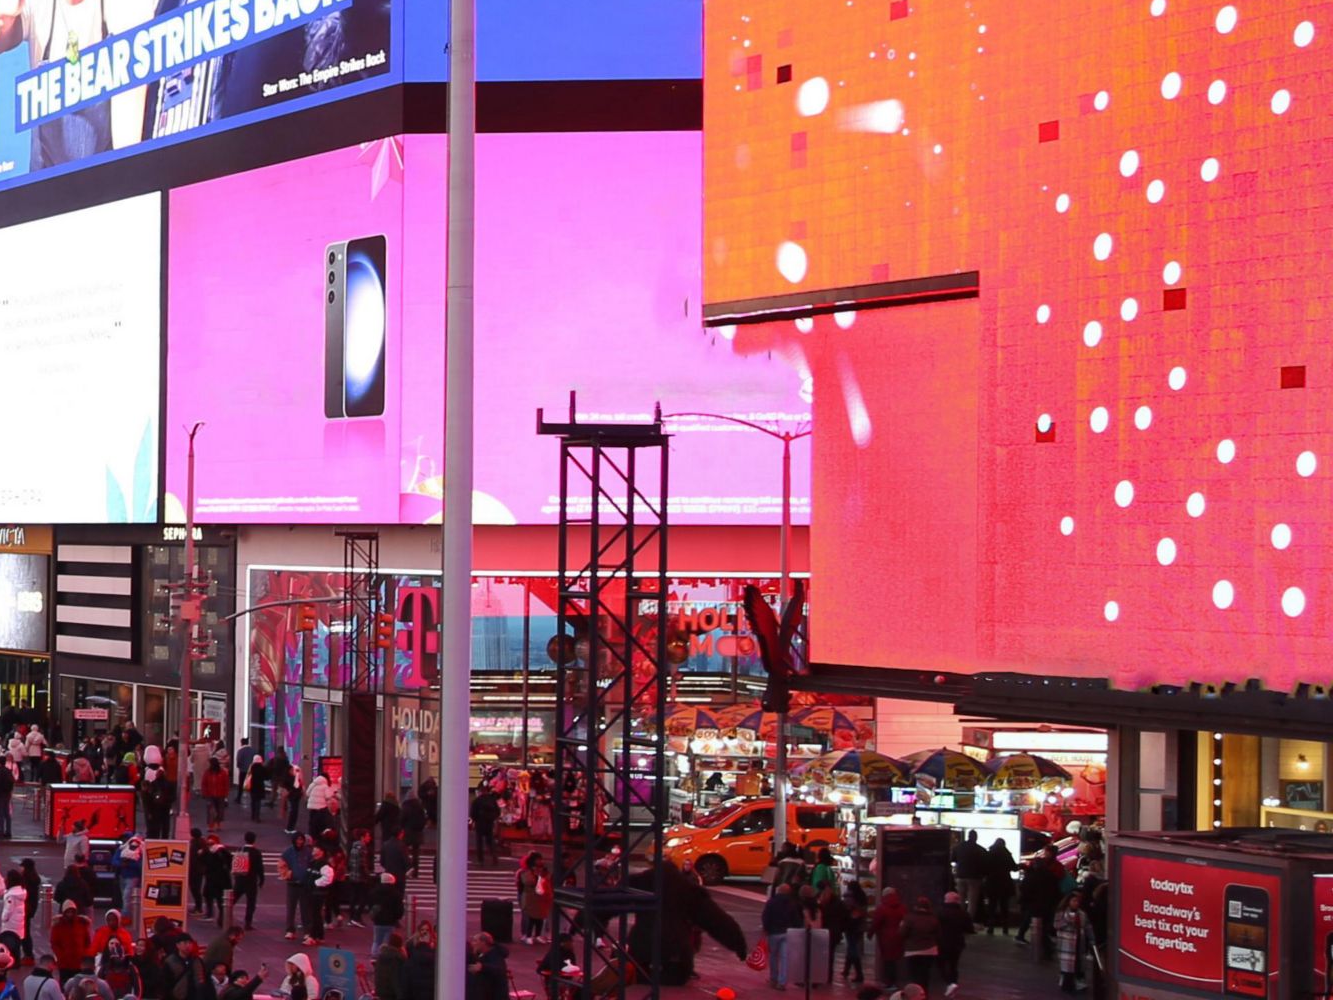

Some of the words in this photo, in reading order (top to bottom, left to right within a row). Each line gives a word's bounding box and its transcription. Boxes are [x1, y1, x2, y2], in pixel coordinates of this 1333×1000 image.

[300, 72, 312, 85] The
[313, 66, 339, 83] Empire
[340, 59, 365, 75] Strikes
[366, 50, 386, 68] Back
[17, 66, 63, 124] THE
[64, 45, 131, 105] BEAR
[1150, 878, 1194, 895] todaytix
[1143, 900, 1201, 922] Broadway's
[1135, 915, 1158, 930] best
[1158, 919, 1171, 931] tix
[1172, 924, 1184, 934] at
[1185, 925, 1209, 938] your
[1145, 932, 1197, 952] fingertips.
